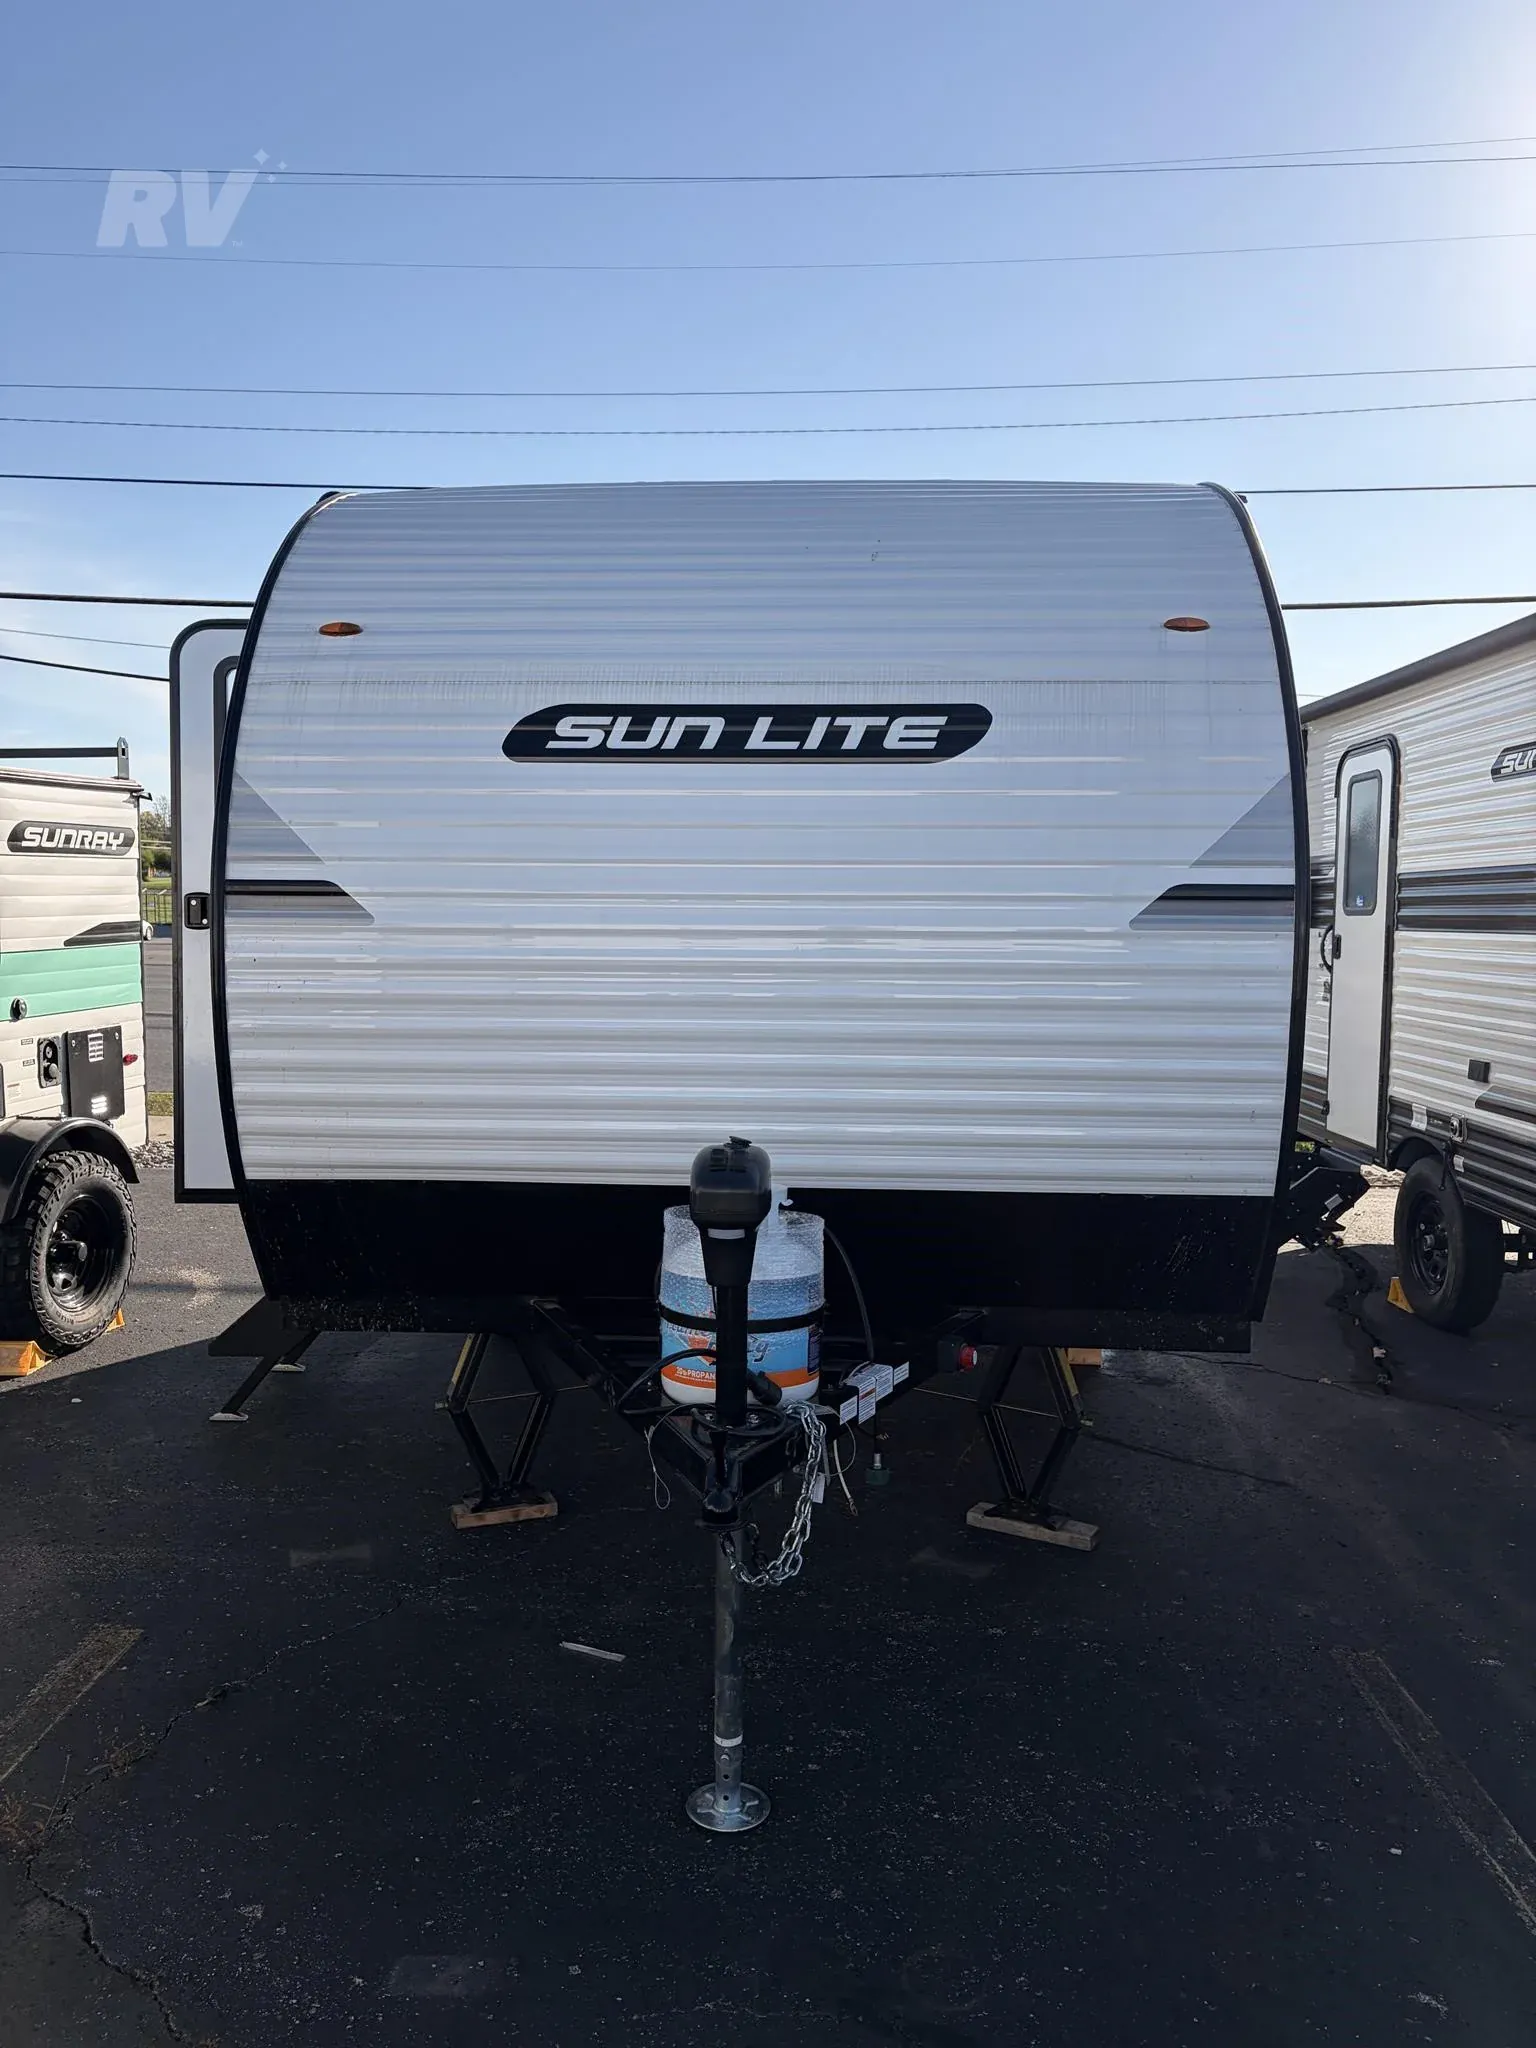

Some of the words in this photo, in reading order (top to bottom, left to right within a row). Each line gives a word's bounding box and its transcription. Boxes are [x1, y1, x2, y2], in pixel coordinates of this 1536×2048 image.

[545, 716, 725, 750] SUN
[744, 716, 948, 750] LITE
[21, 826, 125, 850] SUNRAY
[687, 1369, 717, 1381] PROPAN
